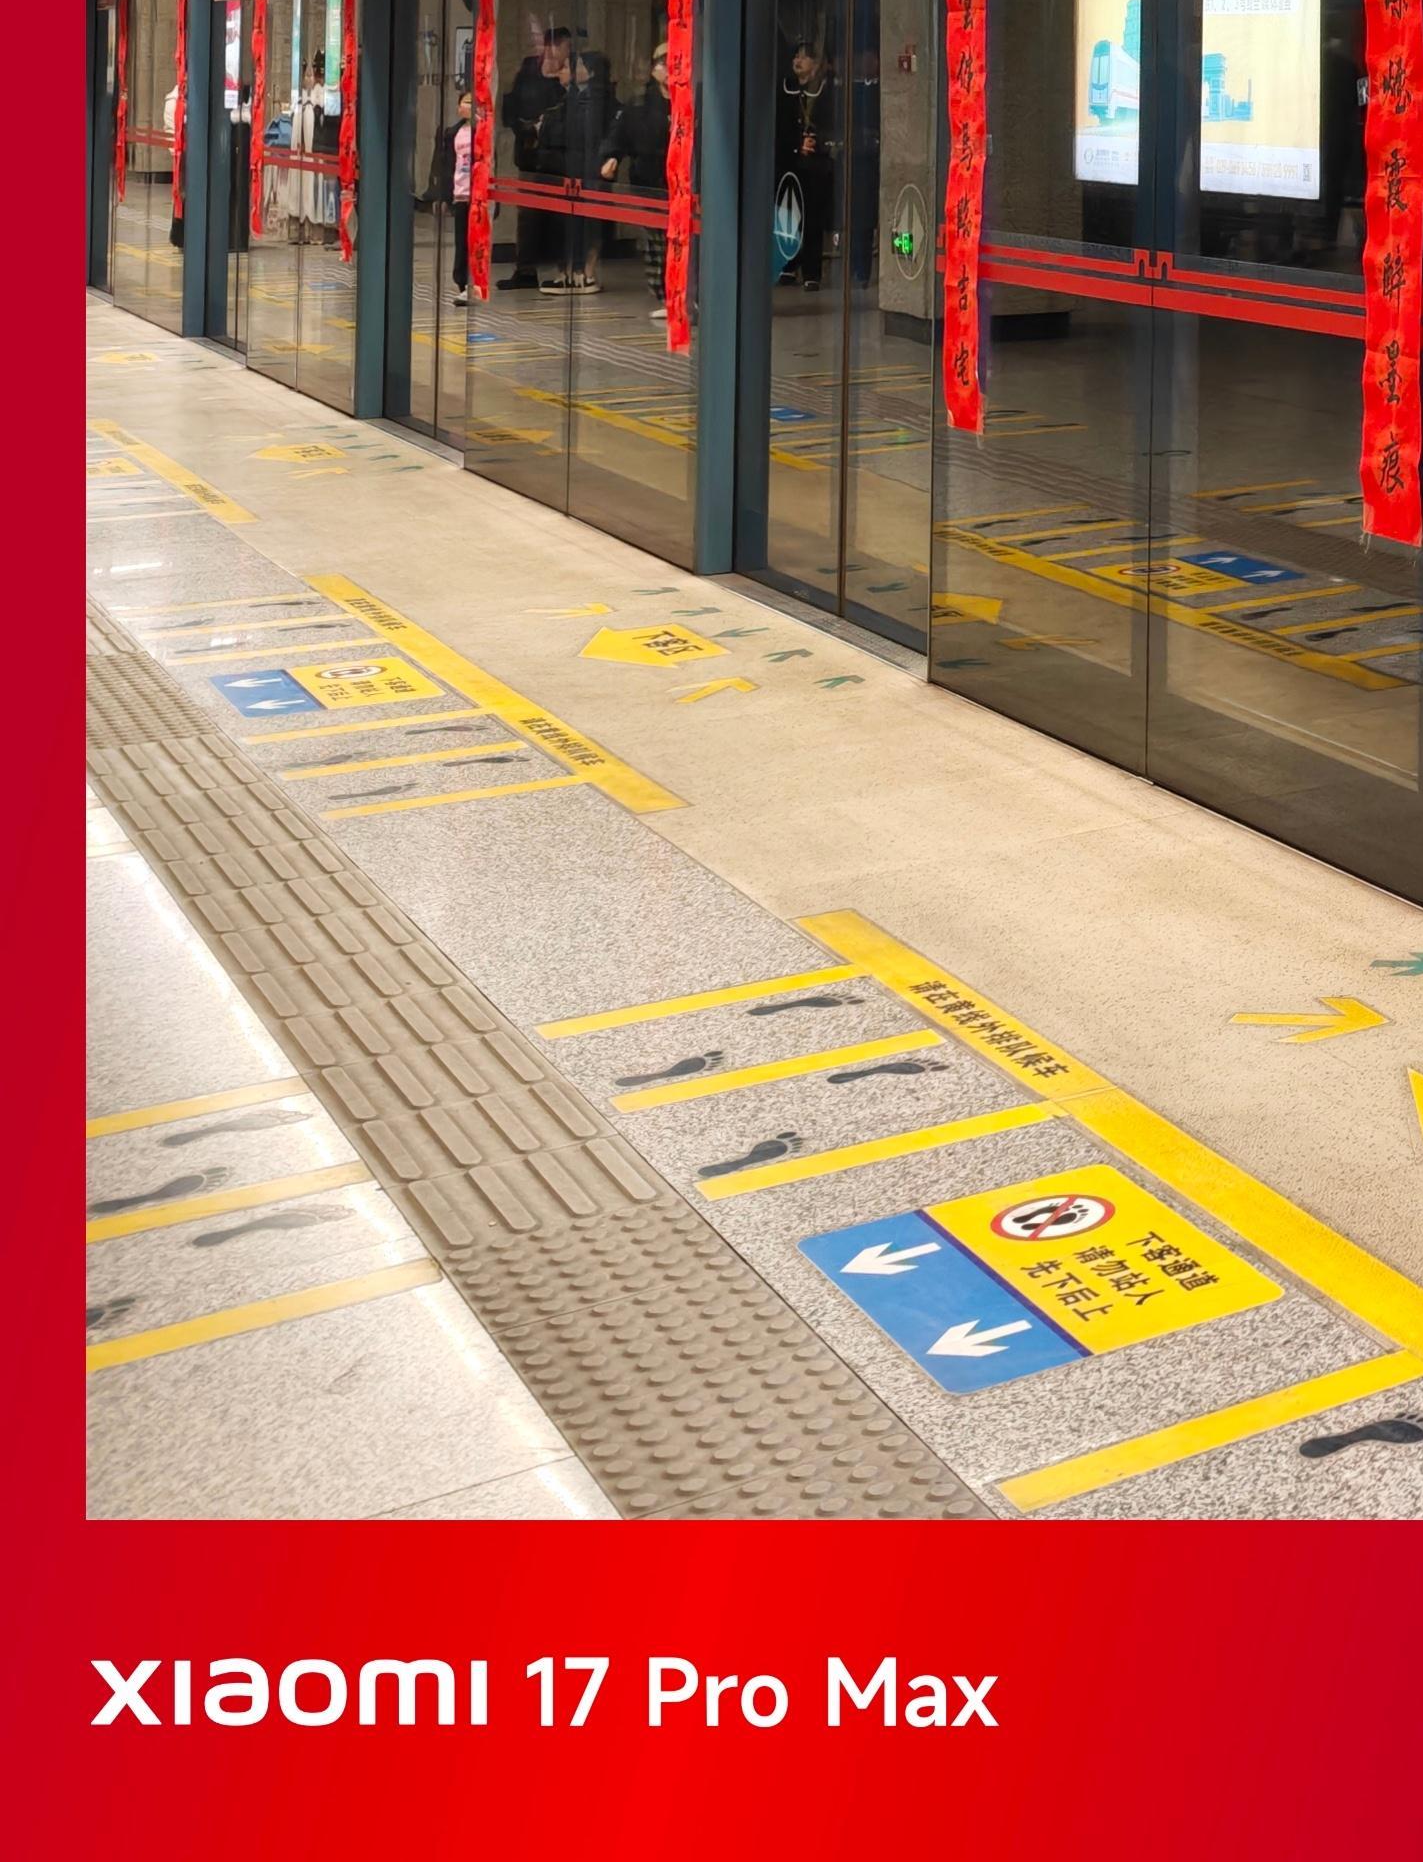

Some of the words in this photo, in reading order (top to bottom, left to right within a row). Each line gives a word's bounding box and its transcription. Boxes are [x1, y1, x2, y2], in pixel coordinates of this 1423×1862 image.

[631, 629, 704, 657] 下客区
[906, 977, 1072, 1082] 请在黄线外排队候车
[1020, 1258, 1114, 1322] 先下后上
[1073, 1244, 1165, 1307] 请勿站人
[1126, 1230, 1220, 1292] 下客通道
